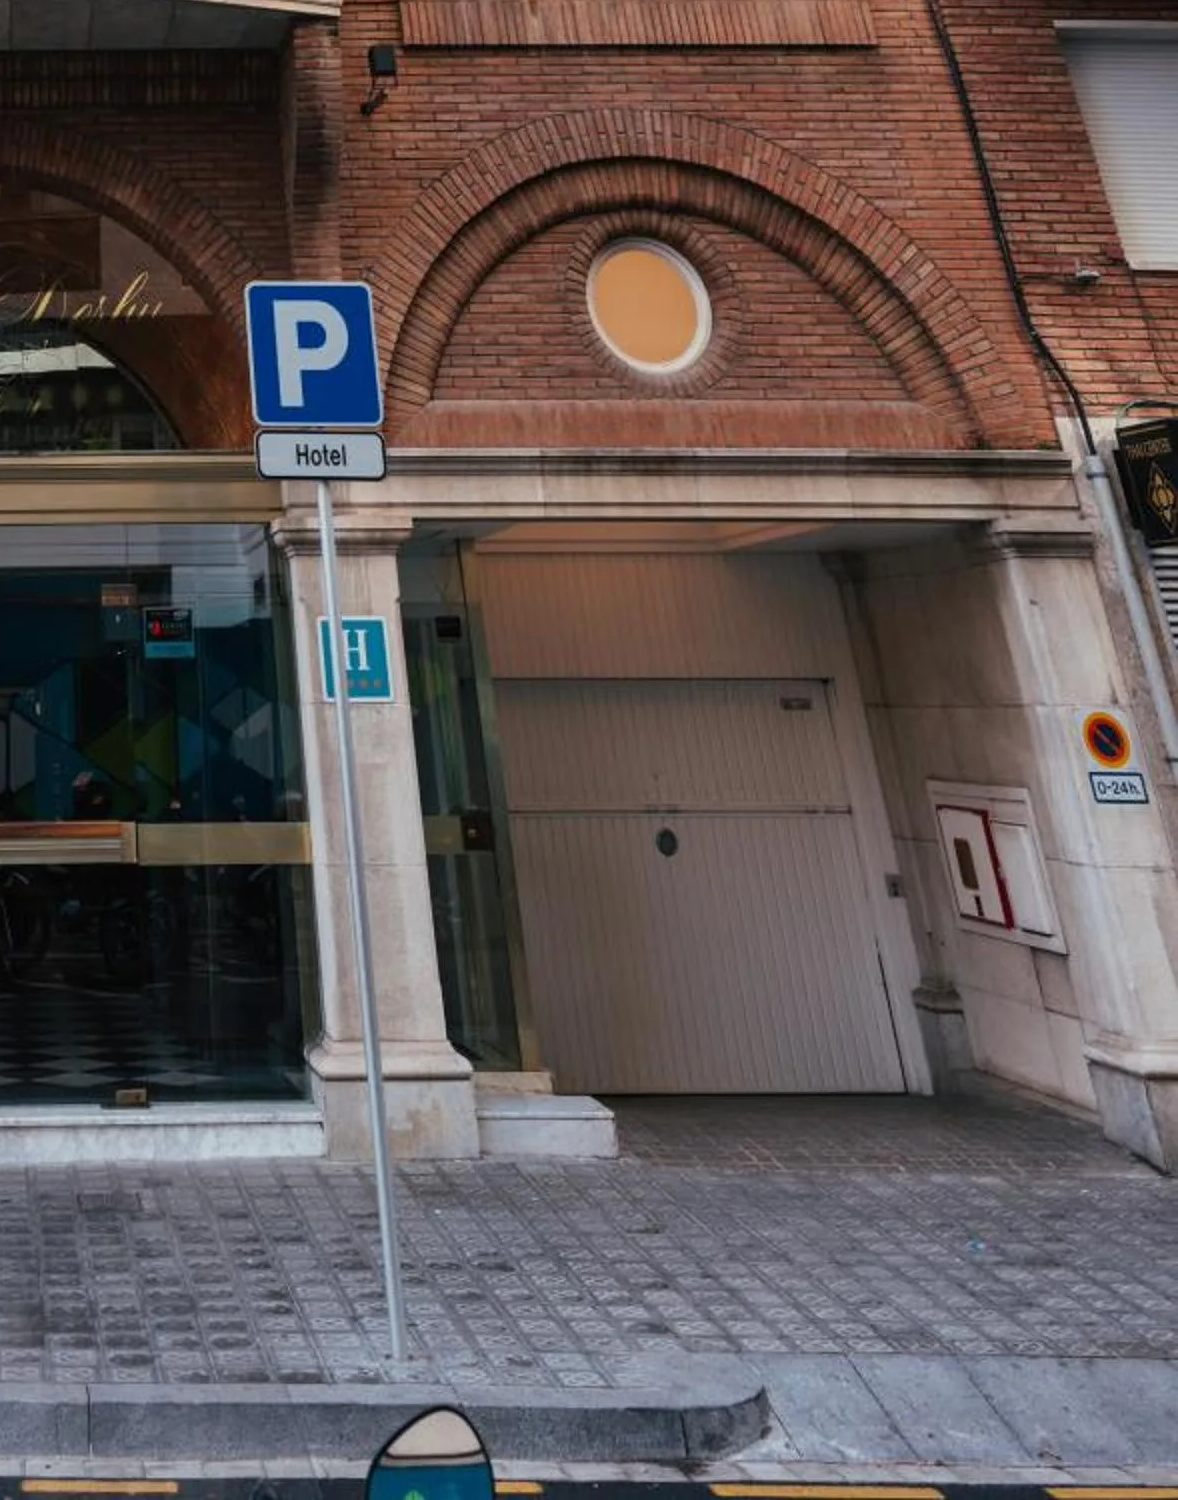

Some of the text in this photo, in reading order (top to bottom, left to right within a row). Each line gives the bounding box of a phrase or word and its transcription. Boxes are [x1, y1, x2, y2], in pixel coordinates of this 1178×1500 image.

[273, 299, 349, 408] P
[295, 443, 348, 467] Hotel
[341, 628, 371, 671] H
